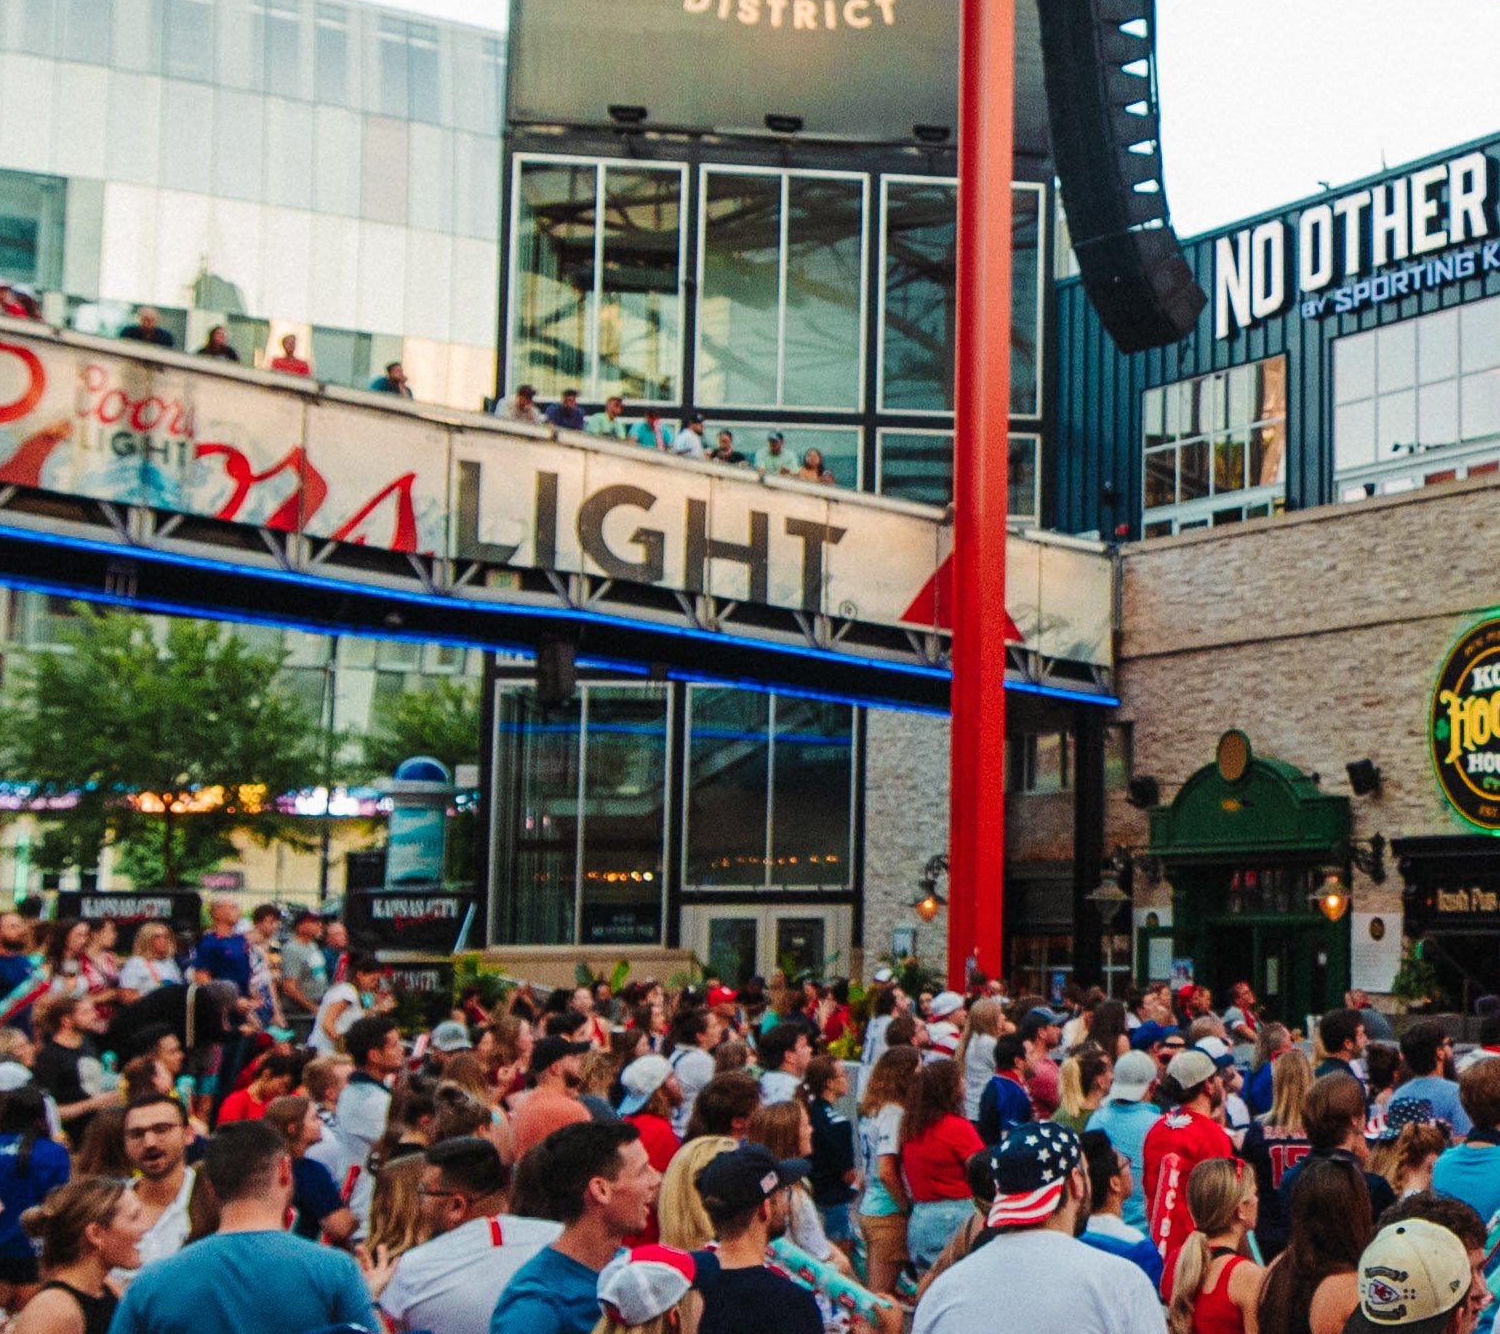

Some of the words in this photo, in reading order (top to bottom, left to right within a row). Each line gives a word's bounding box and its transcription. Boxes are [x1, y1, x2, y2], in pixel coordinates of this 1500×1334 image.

[1215, 220, 1285, 340] NO
[1300, 151, 1488, 293] OTHER
[1301, 298, 1328, 320] BY
[1334, 249, 1477, 316] SPORTING
[458, 459, 848, 614] LIGHT
